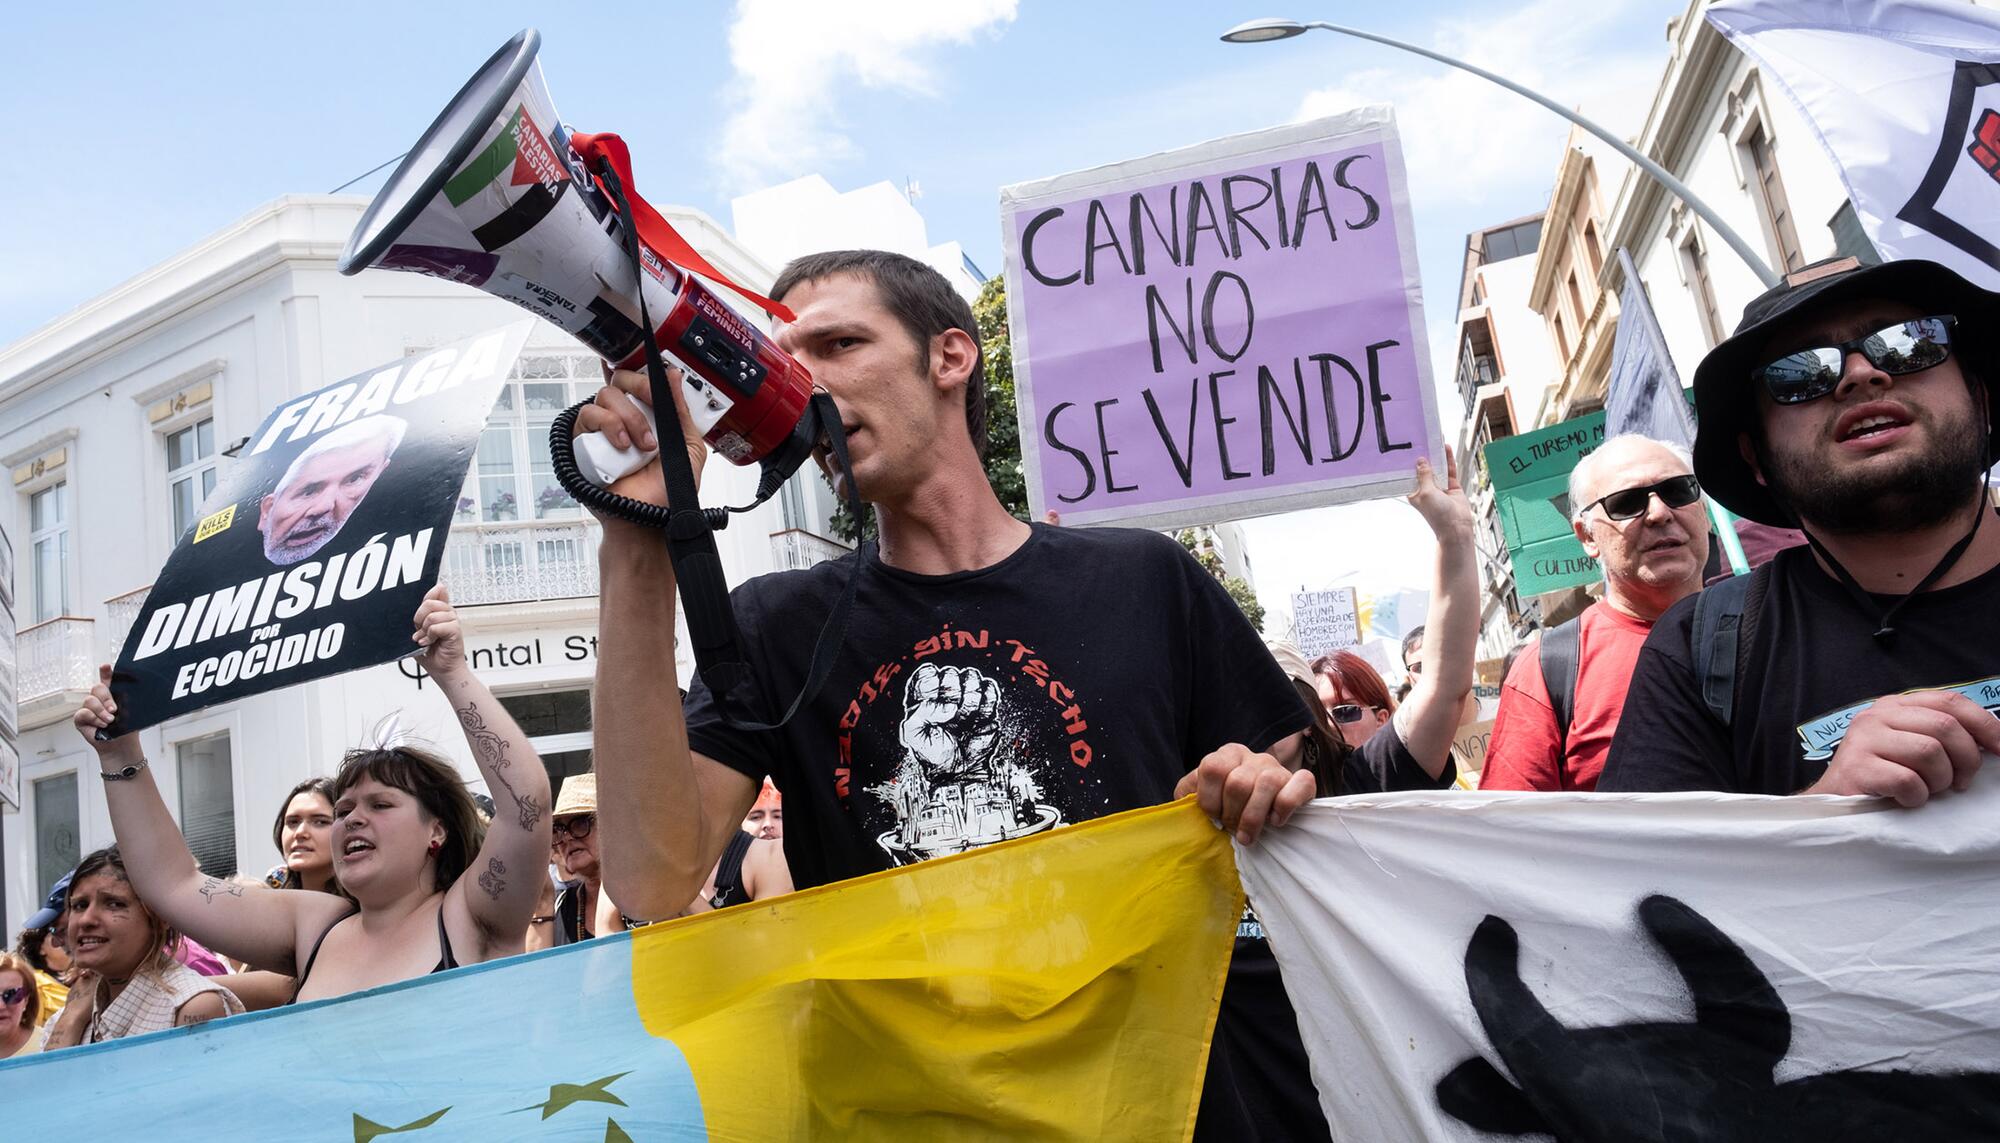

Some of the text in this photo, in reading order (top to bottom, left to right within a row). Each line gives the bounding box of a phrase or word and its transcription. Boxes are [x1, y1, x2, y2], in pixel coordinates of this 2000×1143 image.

[510, 123, 559, 199] PALESTINA
[518, 116, 561, 183] CANARIAS
[1021, 154, 1380, 287] CANARIAS
[696, 299, 753, 352] FEMINISTA
[700, 291, 755, 341] CANARIAS
[1145, 270, 1254, 373] NO
[250, 329, 509, 457] FRAGA
[1044, 339, 1412, 502] SE VENDE
[1508, 456, 1533, 474] EL
[1527, 429, 1587, 461] TURISMO
[132, 527, 435, 662] DIMISIÓN
[1297, 591, 1346, 609] SIEMPRE
[1533, 555, 1600, 577] CULTURA
[171, 622, 345, 700] ECOCIDIO
[249, 623, 281, 643] POR
[1299, 623, 1338, 638] HOMBRES
[1005, 639, 1092, 769] TECHO
